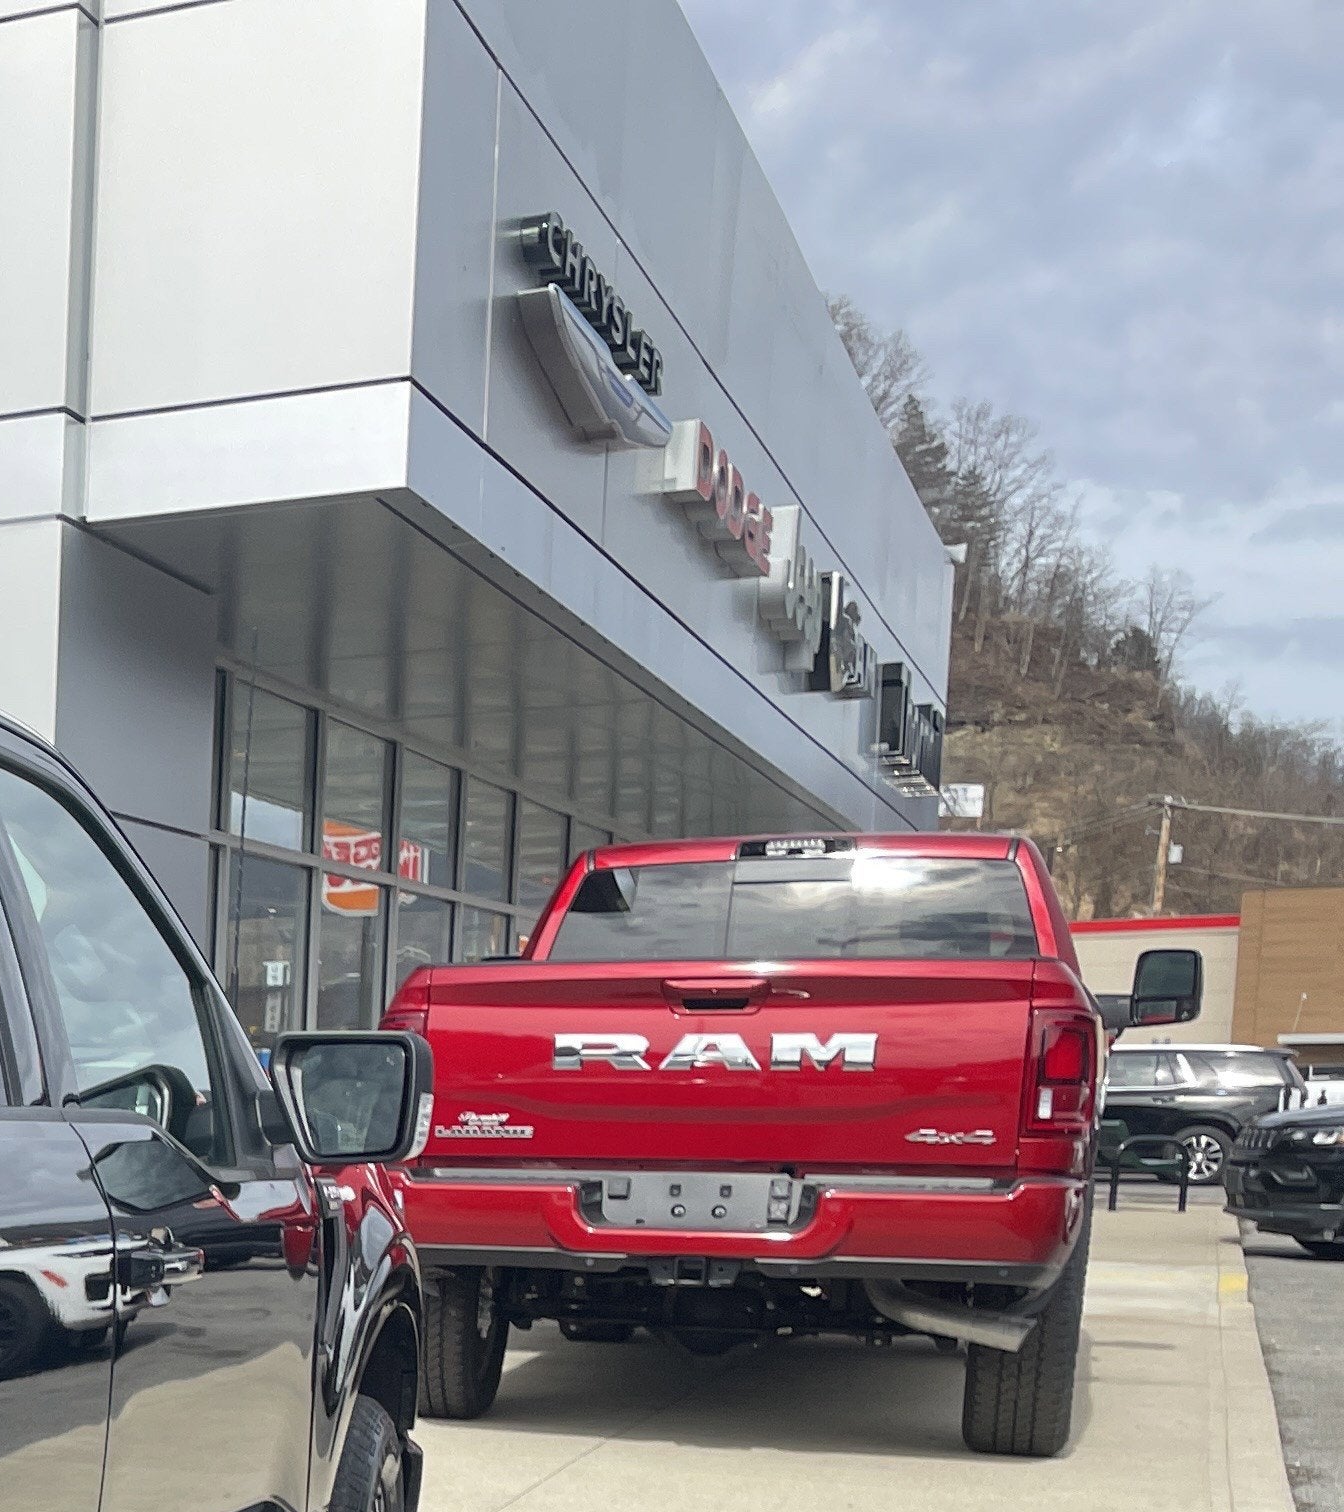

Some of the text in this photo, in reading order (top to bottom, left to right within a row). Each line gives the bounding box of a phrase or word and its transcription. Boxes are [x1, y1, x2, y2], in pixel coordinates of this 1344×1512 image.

[547, 211, 664, 397] CHRYSLER
[696, 420, 774, 578] DODGE
[552, 1032, 880, 1072] RAM
